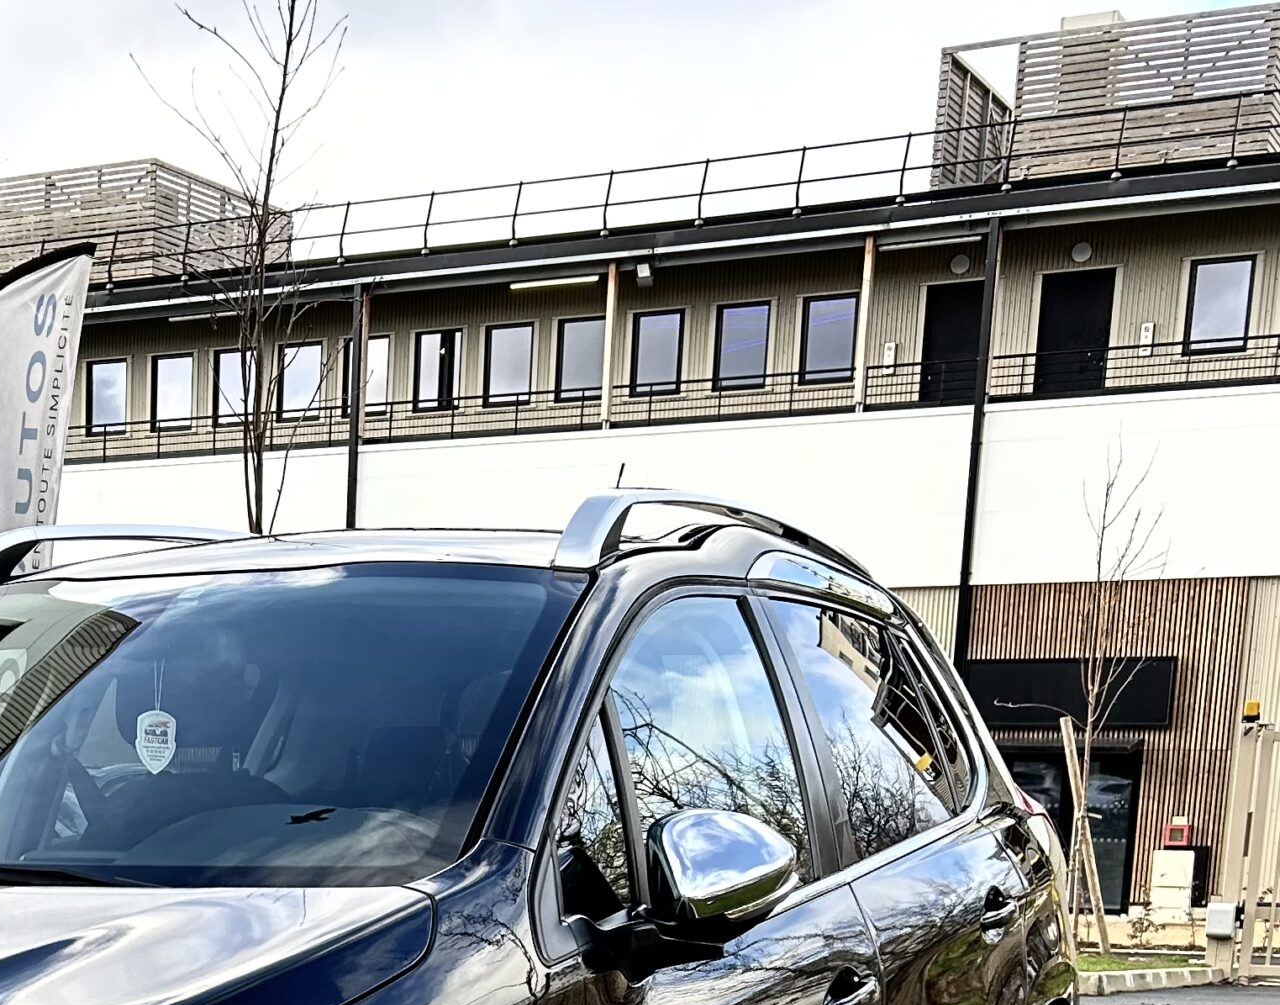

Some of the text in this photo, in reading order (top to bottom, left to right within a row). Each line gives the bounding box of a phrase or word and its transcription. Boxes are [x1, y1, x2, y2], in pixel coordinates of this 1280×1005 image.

[14, 293, 57, 573] UTOS
[35, 447, 53, 527] TOUTE
[46, 294, 74, 437] SIMPLICITÉ
